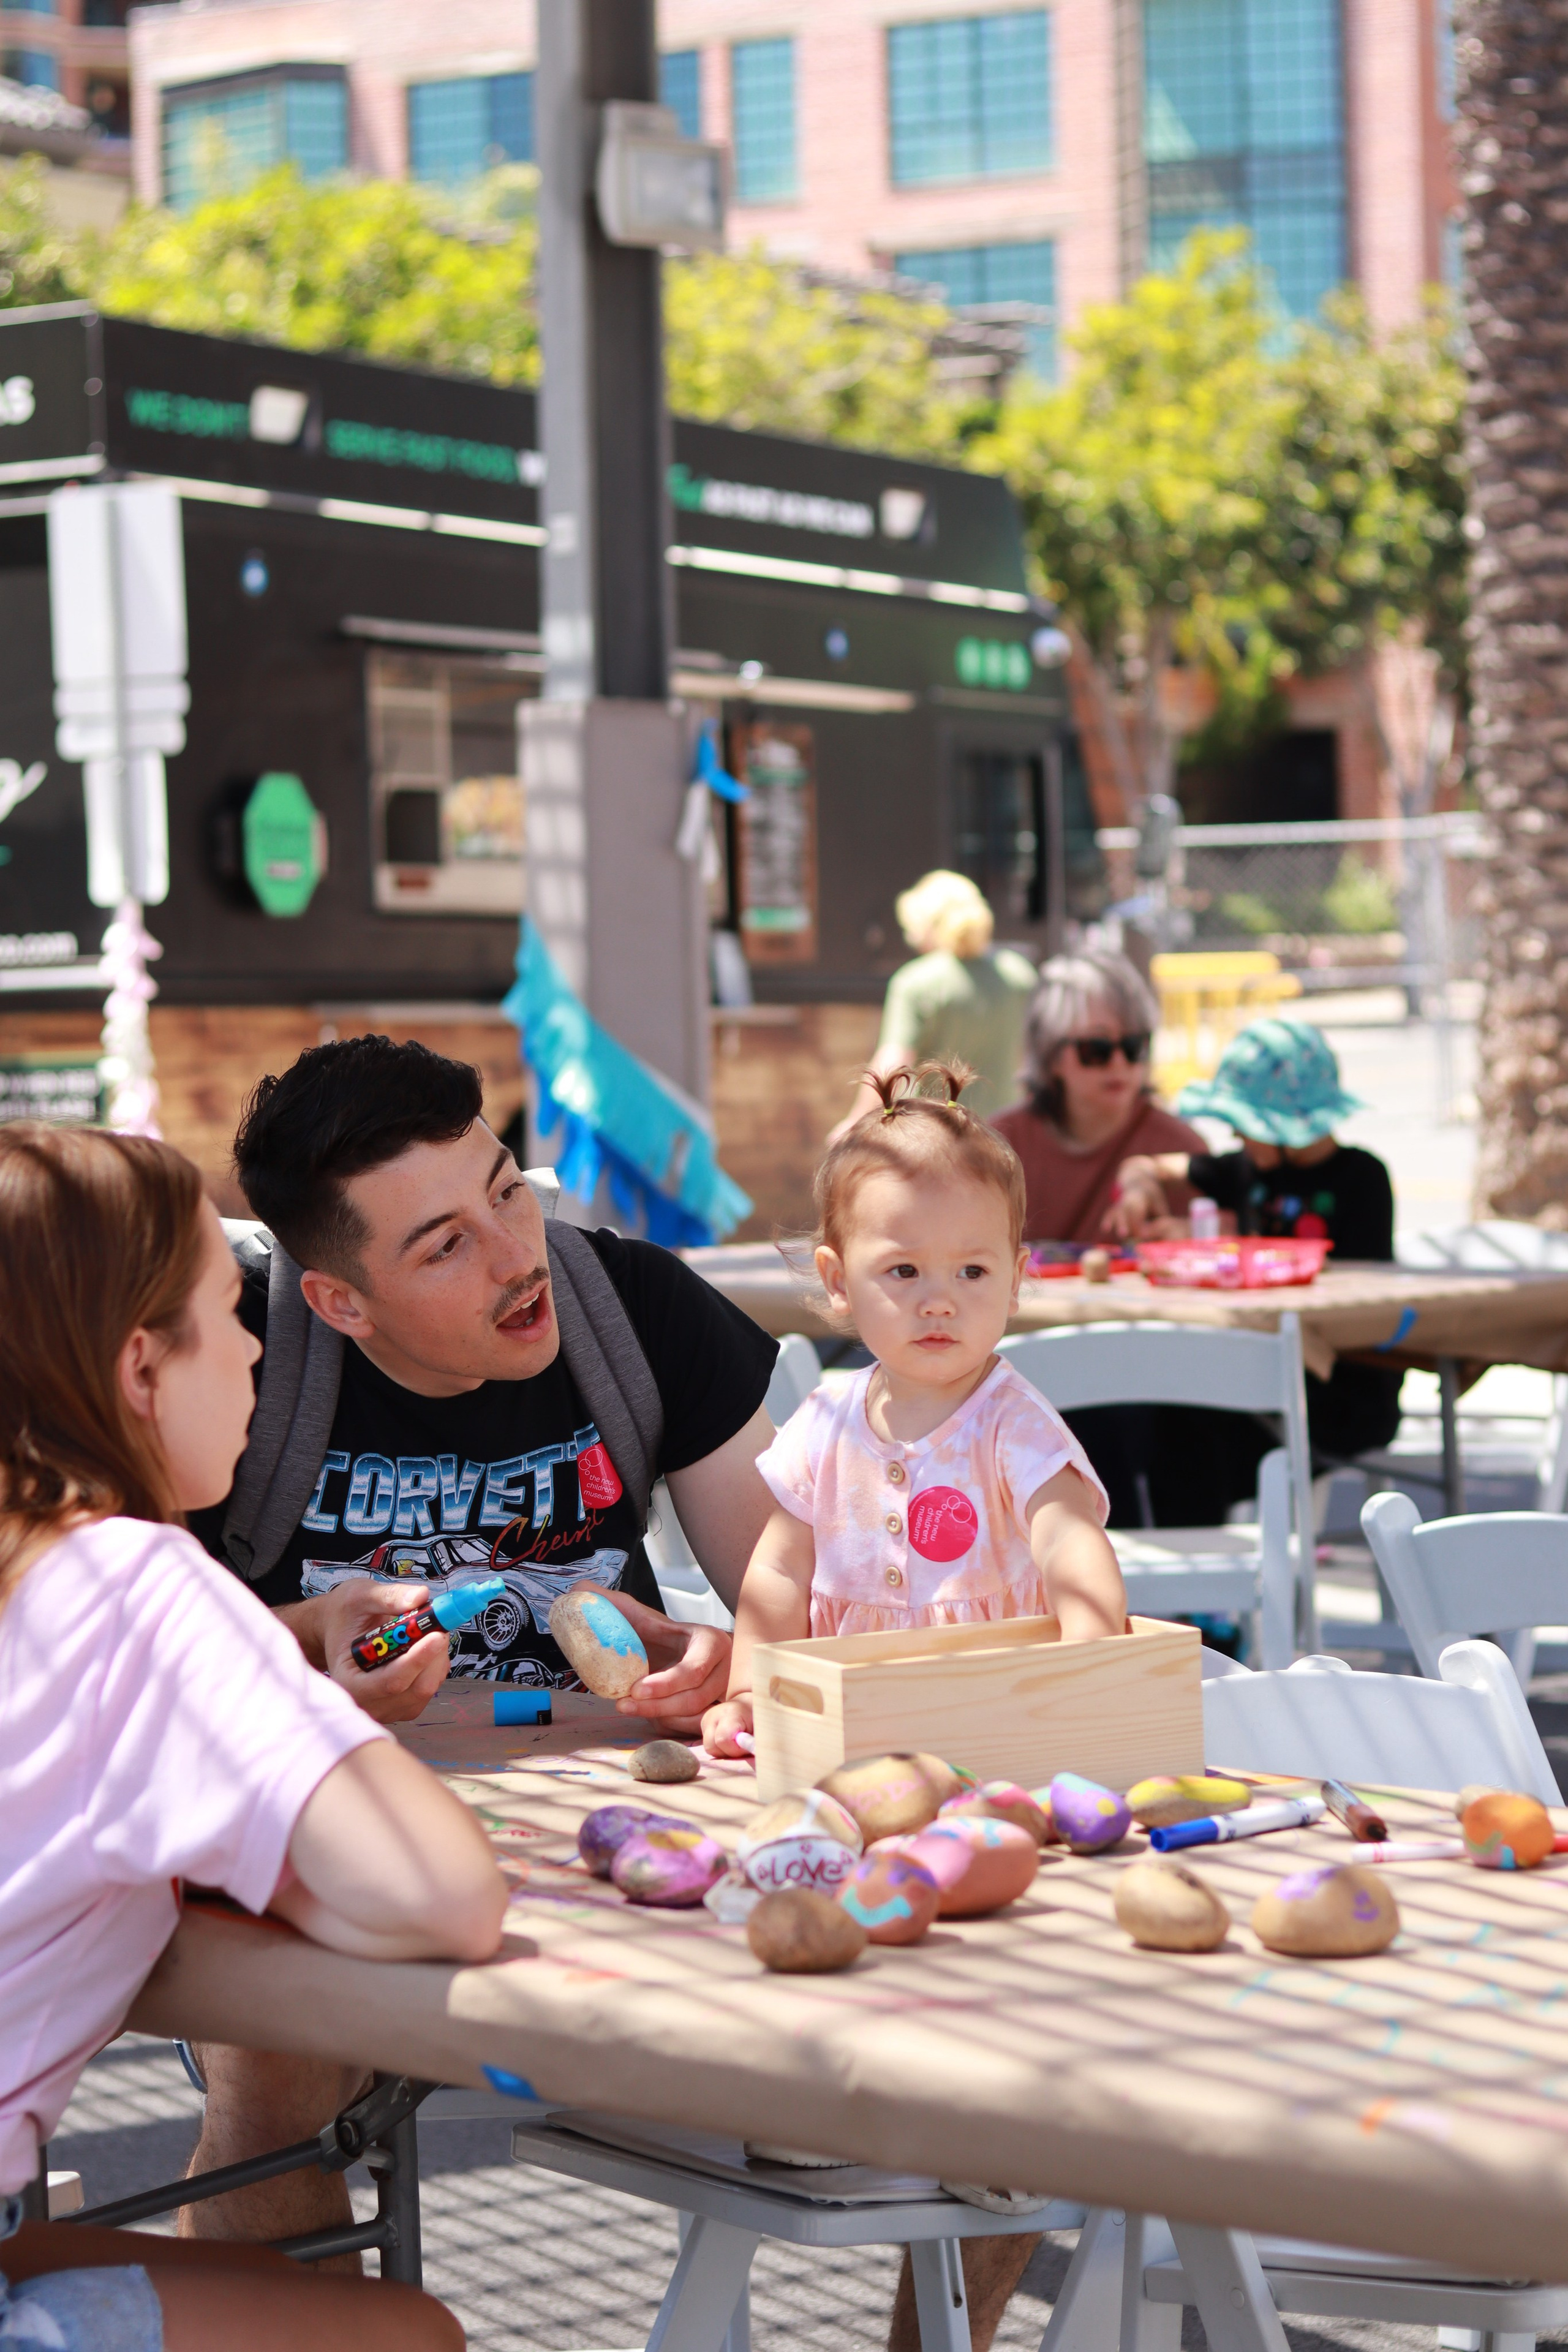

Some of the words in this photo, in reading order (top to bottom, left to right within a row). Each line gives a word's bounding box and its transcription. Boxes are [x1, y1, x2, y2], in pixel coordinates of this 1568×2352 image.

[300, 1422, 601, 1536] CORVETT
[584, 1490, 612, 1501] museum
[586, 1482, 616, 1494] children's
[934, 1510, 943, 1523] the
[921, 1507, 934, 1544] children's
[930, 1524, 939, 1542] new
[418, 1618, 431, 1629] uni
[359, 1618, 423, 1662] POSCA
